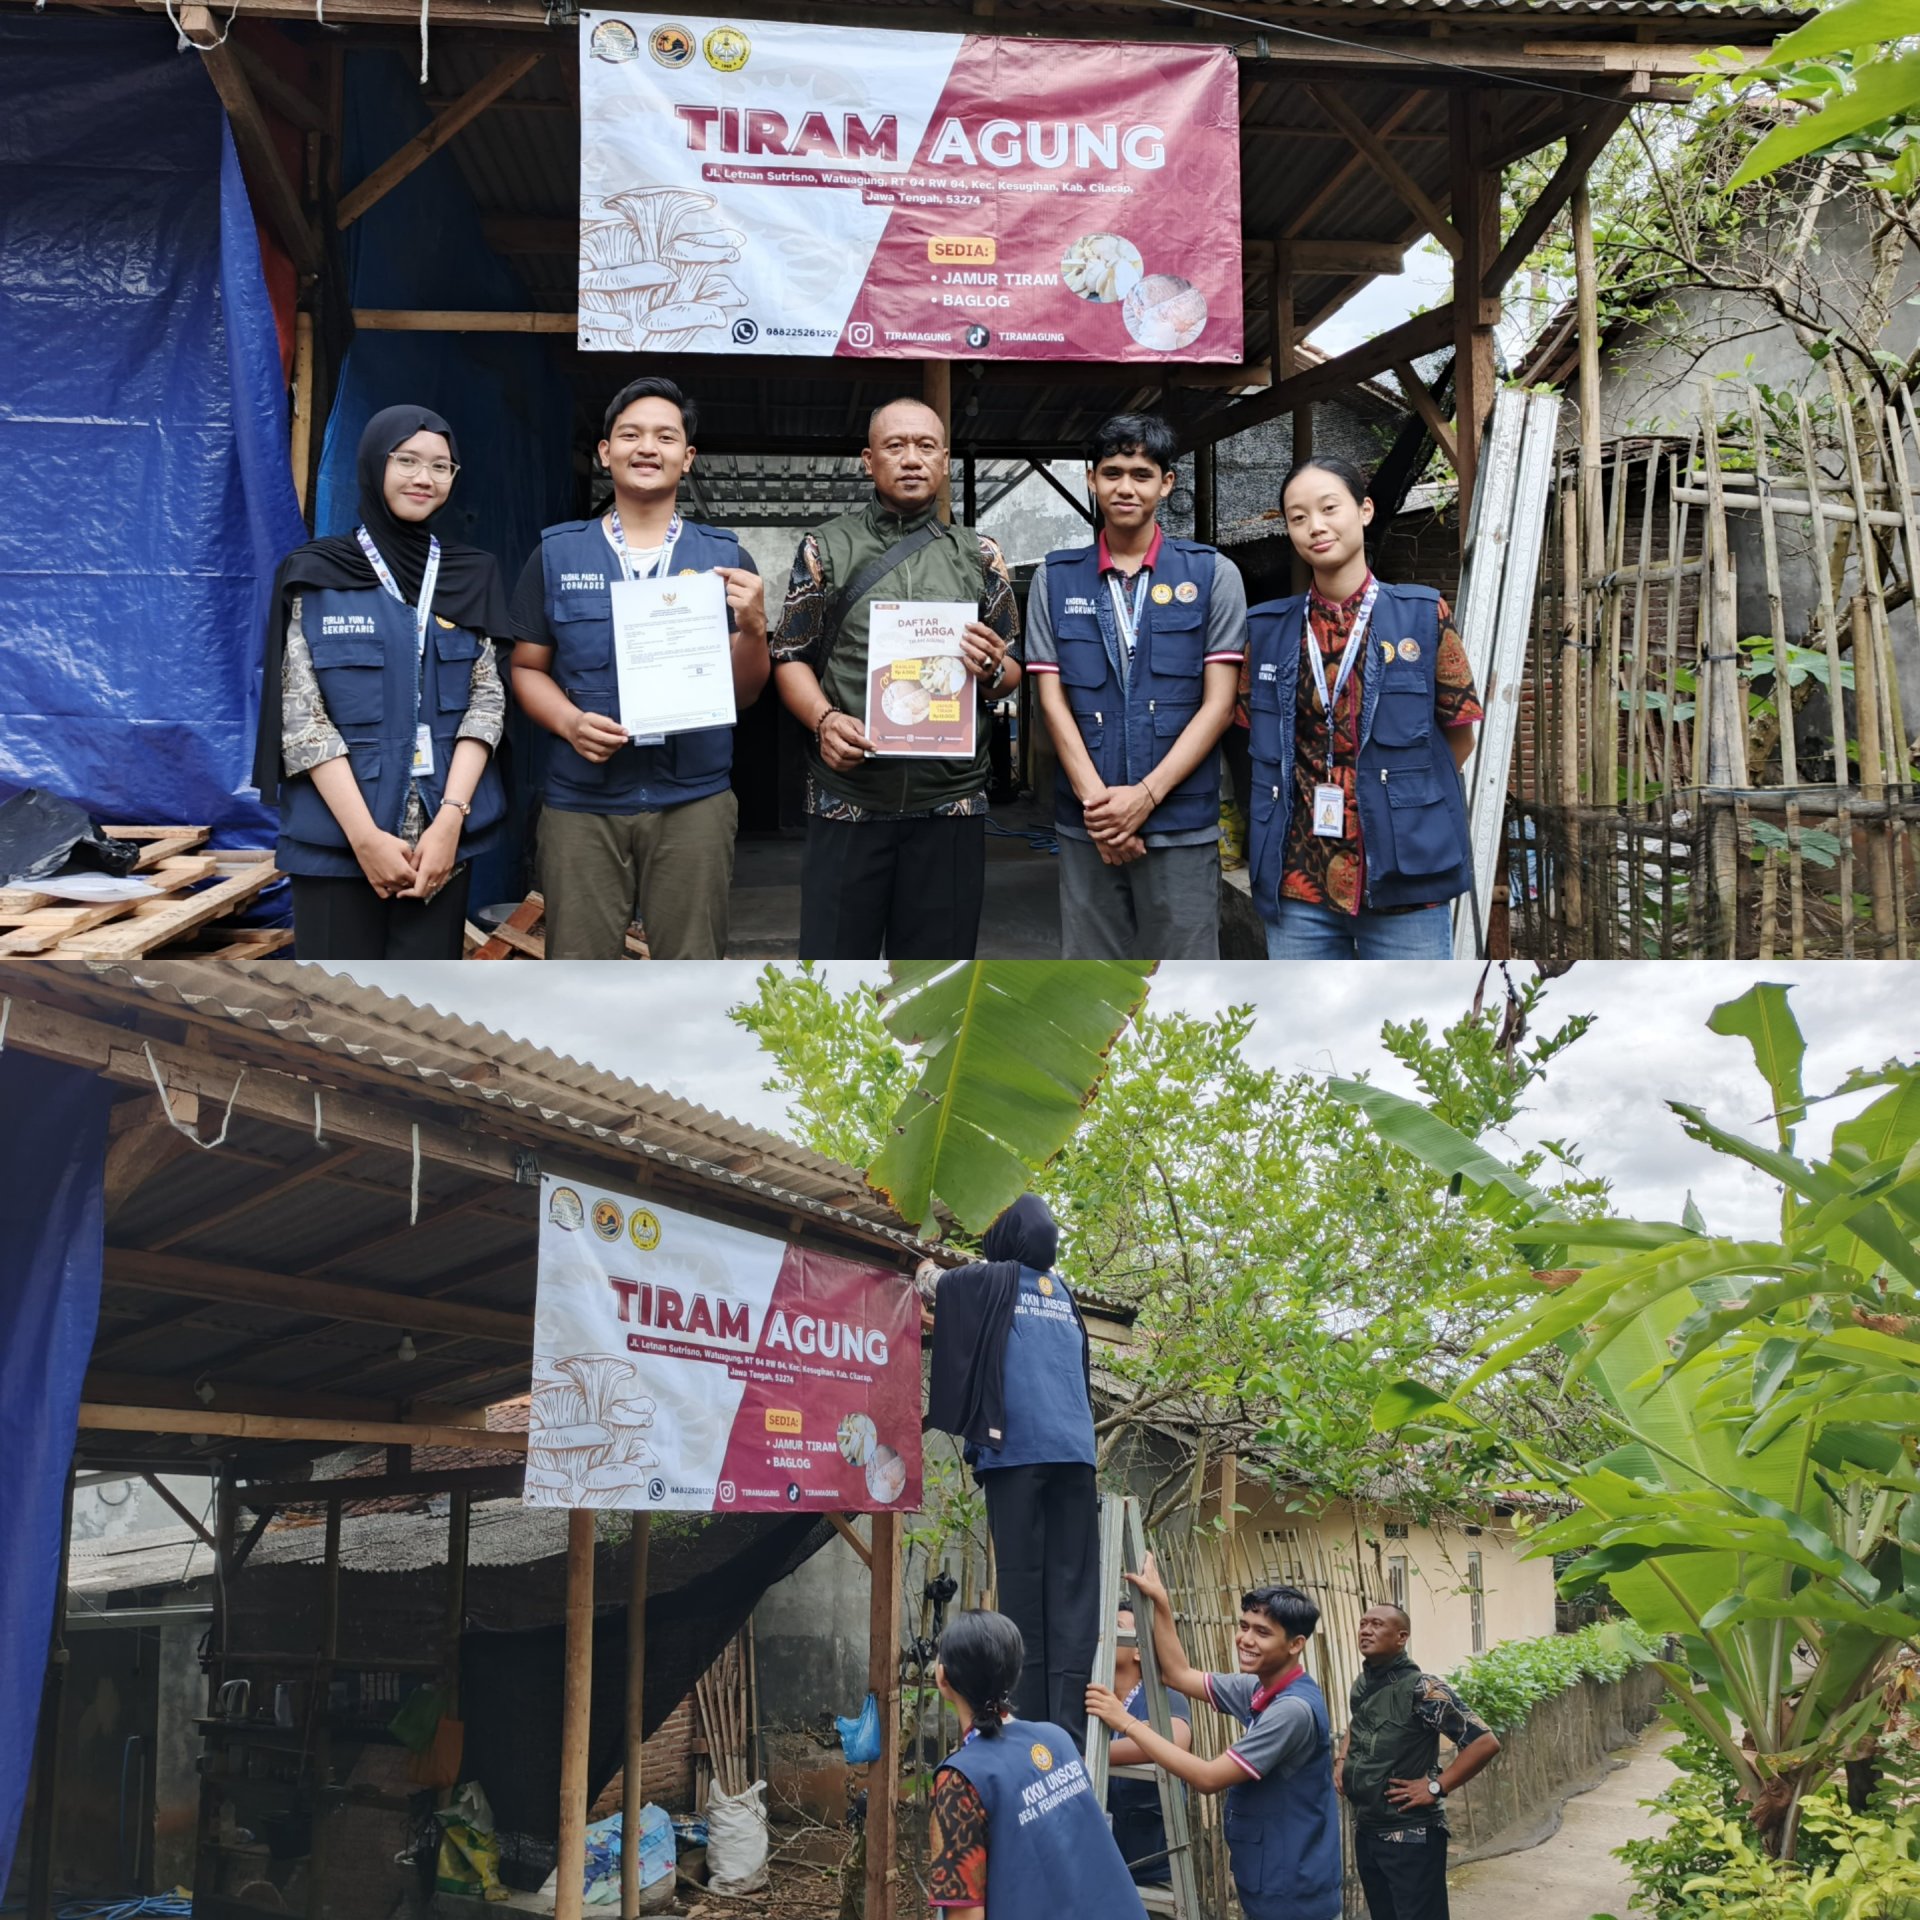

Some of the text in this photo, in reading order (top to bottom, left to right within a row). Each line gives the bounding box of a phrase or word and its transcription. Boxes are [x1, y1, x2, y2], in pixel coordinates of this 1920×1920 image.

[674, 104, 1166, 170] TIRAM AGUNG
[724, 169, 764, 180] Letnan
[767, 171, 818, 184] Sutrisno,
[822, 174, 888, 187] Watuagung,
[891, 177, 907, 186] RT
[909, 178, 925, 187] 04
[929, 179, 947, 188] RW
[950, 180, 969, 190] 04,
[971, 180, 995, 190] Kec.
[998, 181, 1059, 193] Kesugihan,
[1062, 183, 1087, 192] Kab.
[1089, 183, 1134, 194] Cilacap,
[866, 192, 981, 205] Jawa Tengah, 53274
[934, 243, 989, 258] SEDIA:
[942, 272, 1058, 286] JAMUR TIRAM
[942, 294, 1010, 308] BAGLOG
[884, 331, 951, 342] TIRAMAGUNG
[998, 332, 1065, 342] TIRAMAGUNG
[561, 581, 605, 591] KORMADES
[322, 625, 375, 635] SEKRETARIS
[898, 618, 939, 628] DAFTAR
[915, 627, 955, 637] HARGA
[1020, 1292, 1039, 1307] KKN
[607, 1275, 889, 1365] TIRAM AGUNG
[641, 1339, 667, 1352] Letnan
[668, 1345, 702, 1358] Sutrisno,
[704, 1349, 743, 1364] Watuagung,
[744, 1355, 753, 1364] RT
[730, 1368, 748, 1377] Jawa
[749, 1370, 774, 1383] Tengah,
[768, 1415, 799, 1427] SEDIA:
[772, 1438, 837, 1453] JAMUR TIRAM
[773, 1457, 811, 1469] BAGLOG
[1021, 1760, 1083, 1807] KKN UNSOED
[1018, 1806, 1039, 1826] DESA
